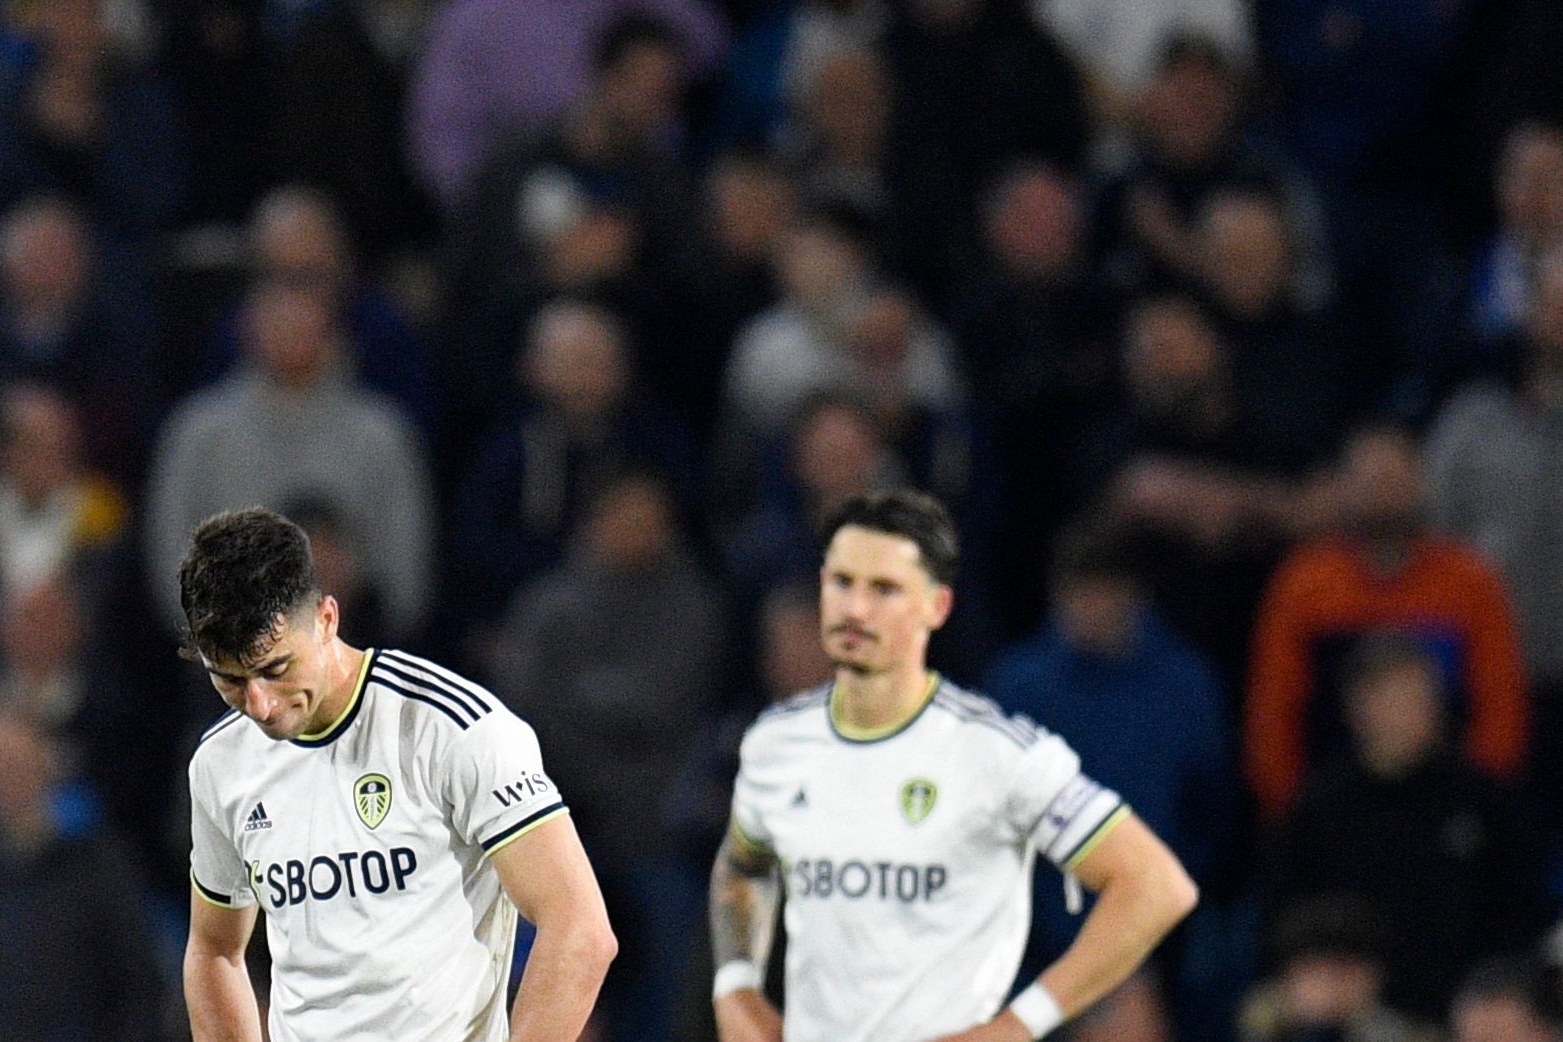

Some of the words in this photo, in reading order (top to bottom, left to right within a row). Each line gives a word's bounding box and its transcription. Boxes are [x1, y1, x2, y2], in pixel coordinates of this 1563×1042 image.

[492, 770, 554, 808] wis
[267, 847, 418, 909] SBOTOP
[796, 858, 947, 904] SBOTOP
